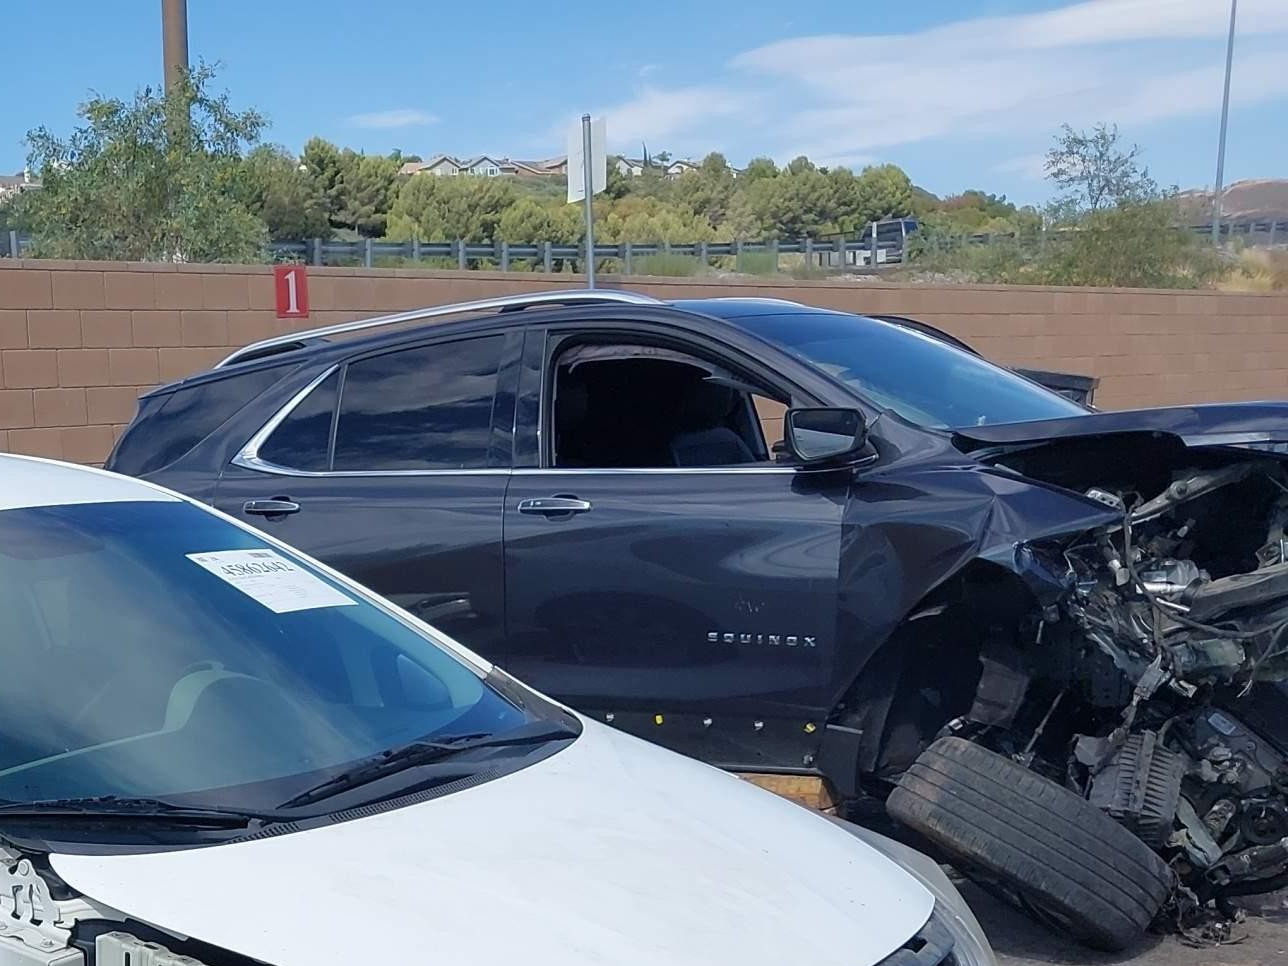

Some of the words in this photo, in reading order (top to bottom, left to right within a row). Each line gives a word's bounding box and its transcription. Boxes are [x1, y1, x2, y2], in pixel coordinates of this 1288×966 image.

[283, 270, 301, 313] 1
[220, 561, 294, 577] 45862642
[707, 632, 816, 647] EQUINOX
